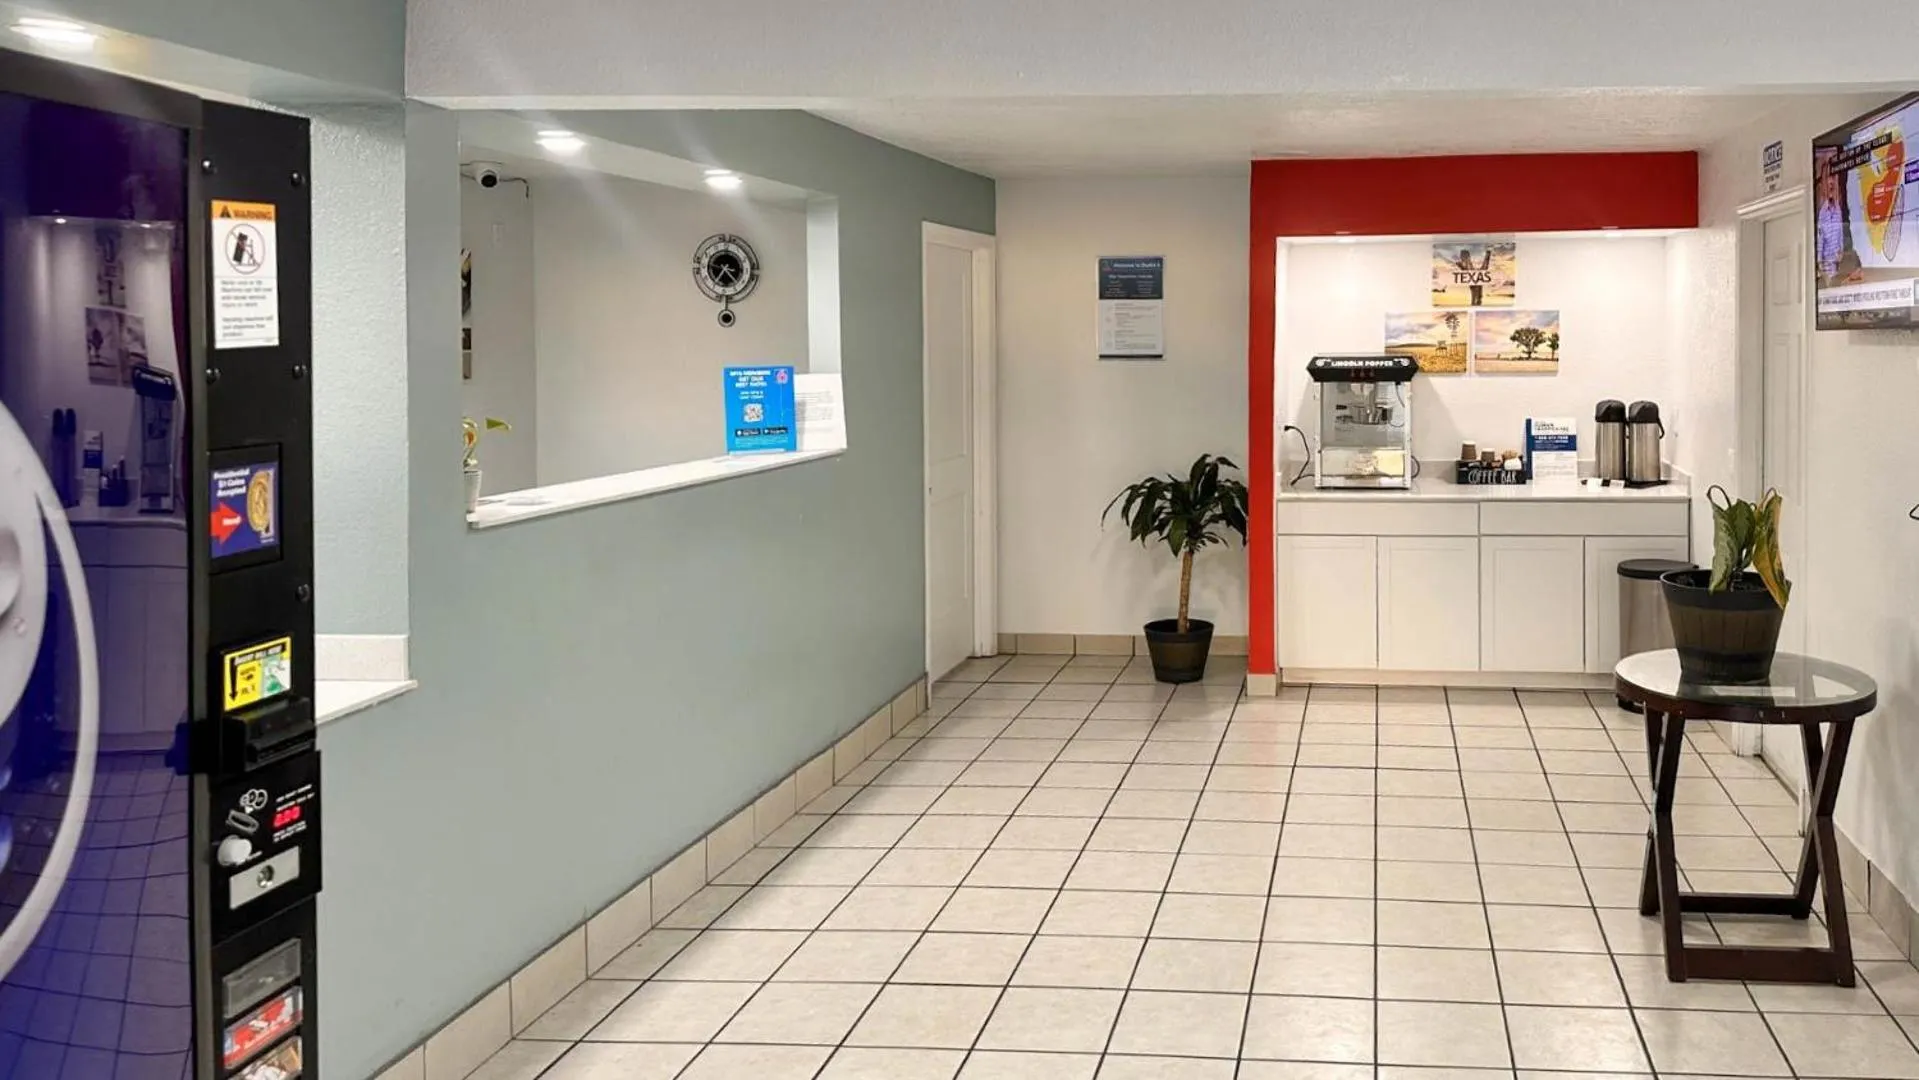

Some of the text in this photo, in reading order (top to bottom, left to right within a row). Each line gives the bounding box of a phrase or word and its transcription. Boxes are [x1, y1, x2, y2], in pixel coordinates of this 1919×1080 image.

[1453, 271, 1491, 284] TEXAS
[1468, 469, 1517, 484] COFFEE BAR
